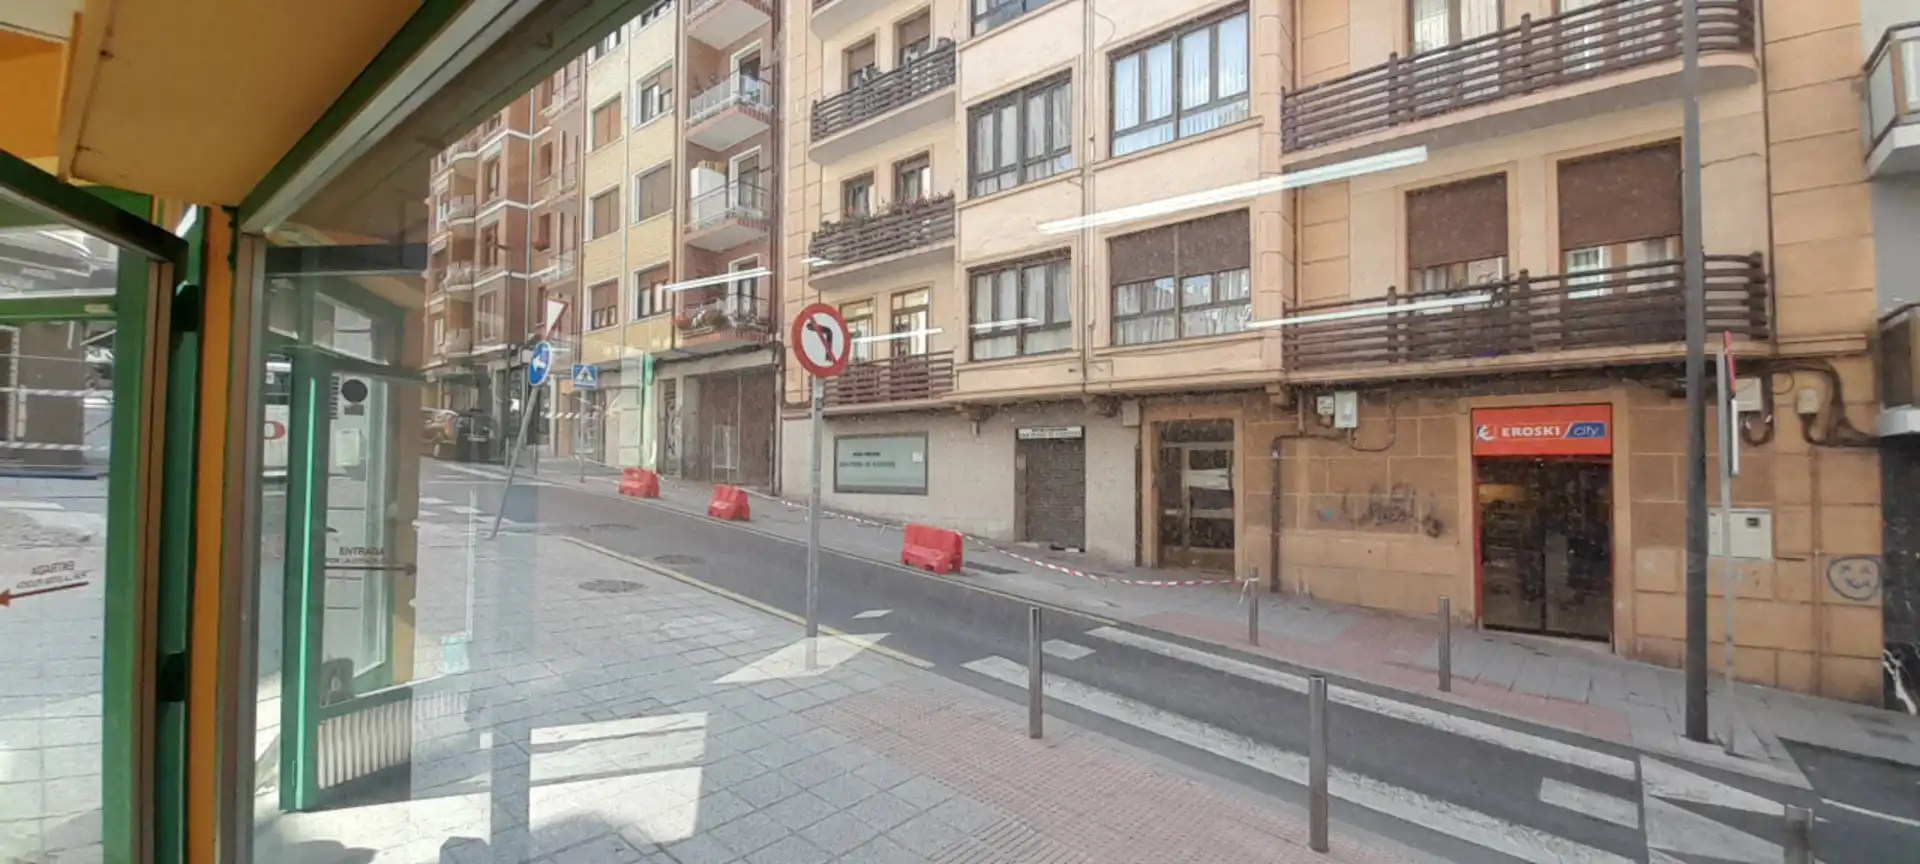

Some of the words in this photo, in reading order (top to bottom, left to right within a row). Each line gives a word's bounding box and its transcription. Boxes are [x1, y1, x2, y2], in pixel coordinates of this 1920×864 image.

[1501, 425, 1561, 437] EROSKI
[1573, 424, 1600, 437] city
[339, 547, 385, 556] ENTRADA
